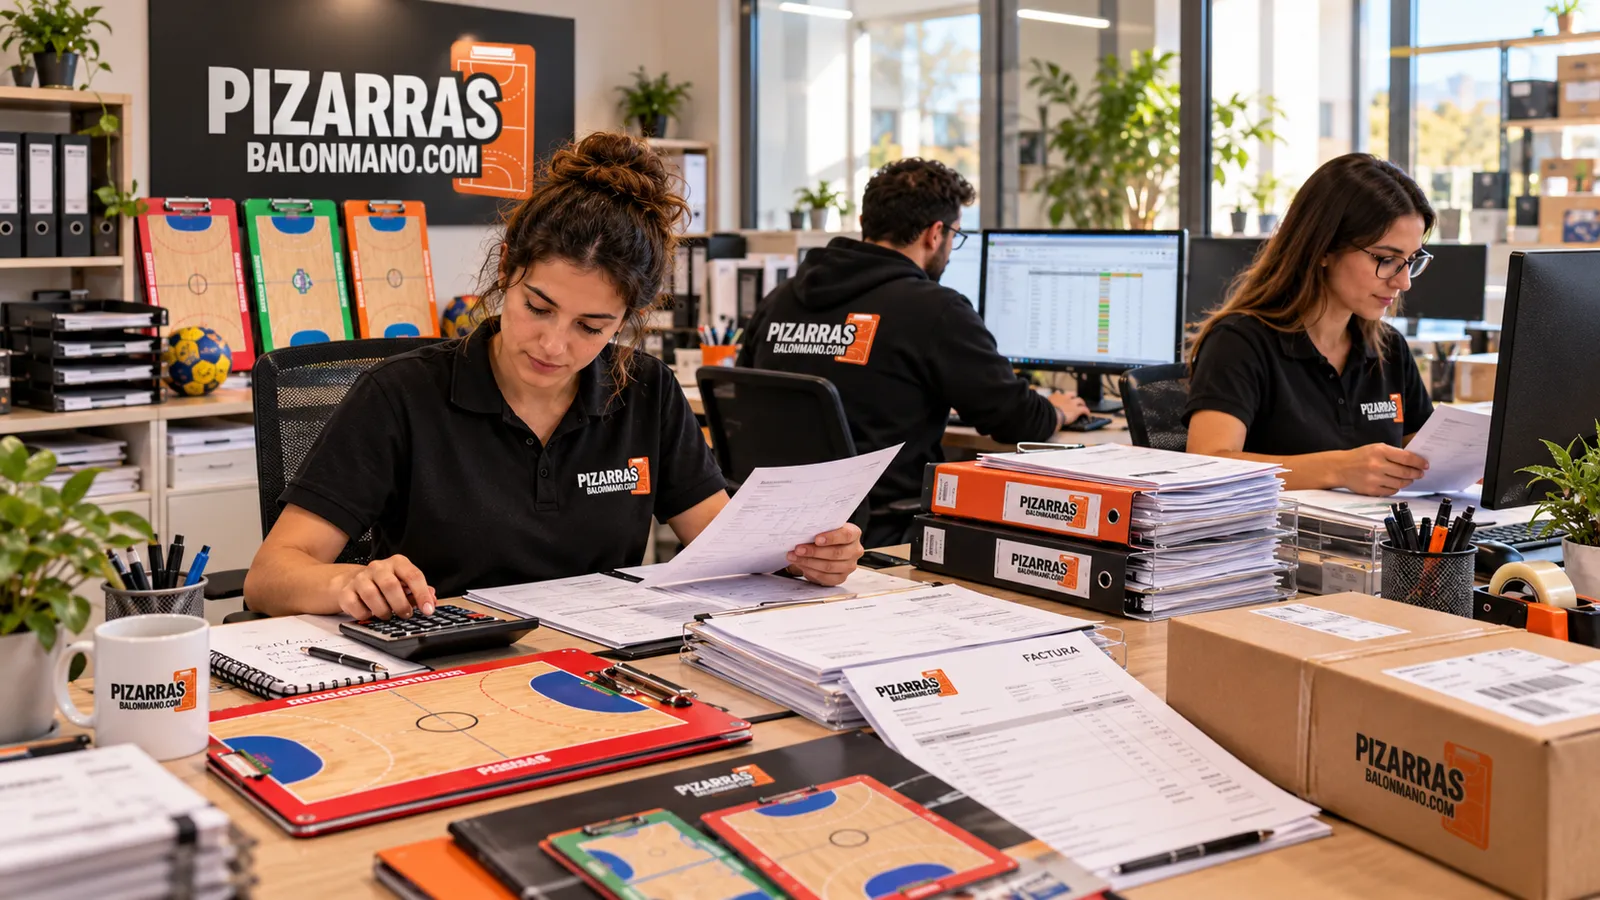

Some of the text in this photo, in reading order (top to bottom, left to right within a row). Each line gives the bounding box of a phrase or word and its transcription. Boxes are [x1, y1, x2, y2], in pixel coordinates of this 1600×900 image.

[207, 66, 499, 140] PIZARRAS
[246, 141, 478, 174] BALONMANO.COM
[765, 322, 857, 345] PIZARRAS
[773, 343, 847, 356] BALONMANO.COM
[577, 467, 639, 488] PIZARRAS
[1020, 495, 1078, 516] PIZARRAS
[1011, 553, 1068, 576] PIZARRAS
[1022, 646, 1081, 663] FACTURA
[111, 680, 186, 701] PIZARRAS
[875, 677, 940, 698] PIZARRAS
[119, 698, 182, 711] BALONMANO.COM
[1355, 732, 1465, 802] PIZARRAS
[673, 771, 754, 797] PIZARRAS
[1365, 767, 1455, 819] BALONMANO.COM
